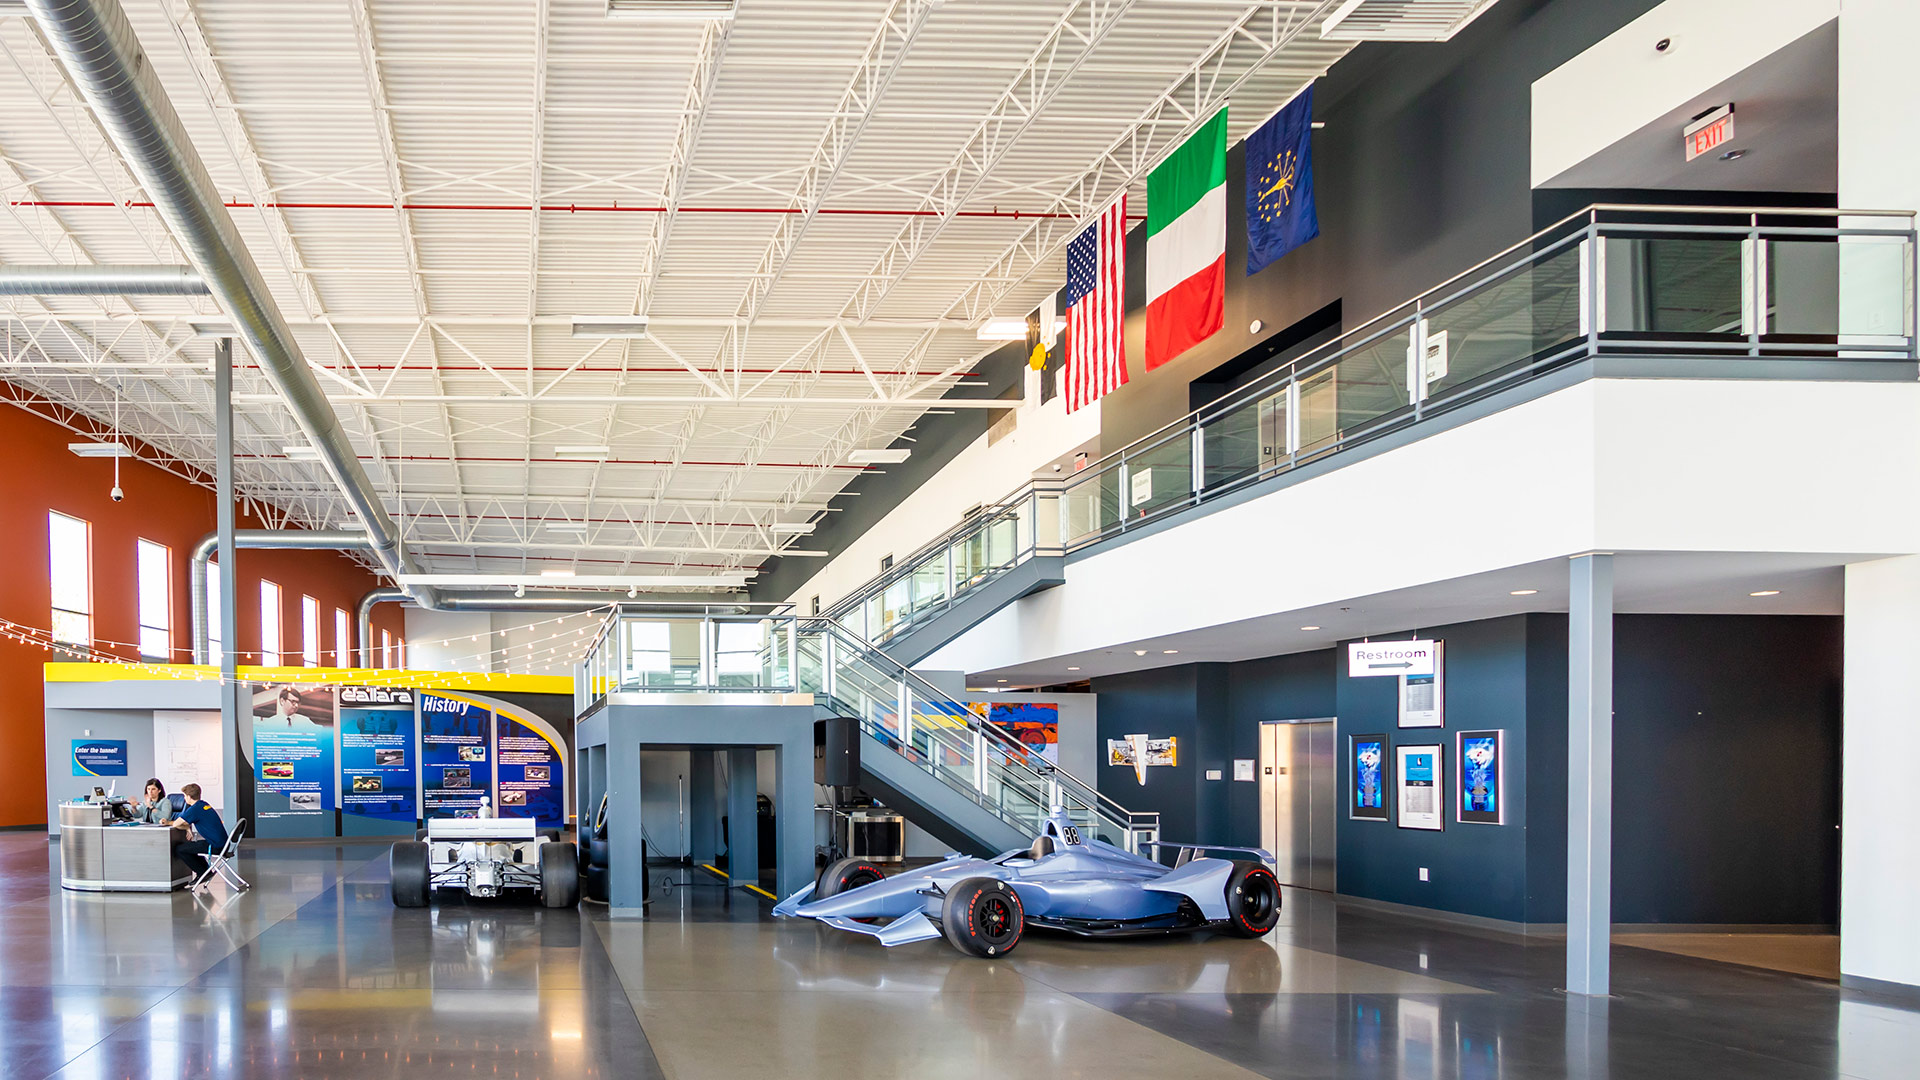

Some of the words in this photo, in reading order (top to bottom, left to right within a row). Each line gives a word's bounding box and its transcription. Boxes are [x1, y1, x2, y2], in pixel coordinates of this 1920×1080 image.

[1695, 118, 1727, 155] EXIT
[1356, 650, 1427, 660] Restroom
[423, 696, 470, 716] History
[1063, 827, 1081, 845] 88
